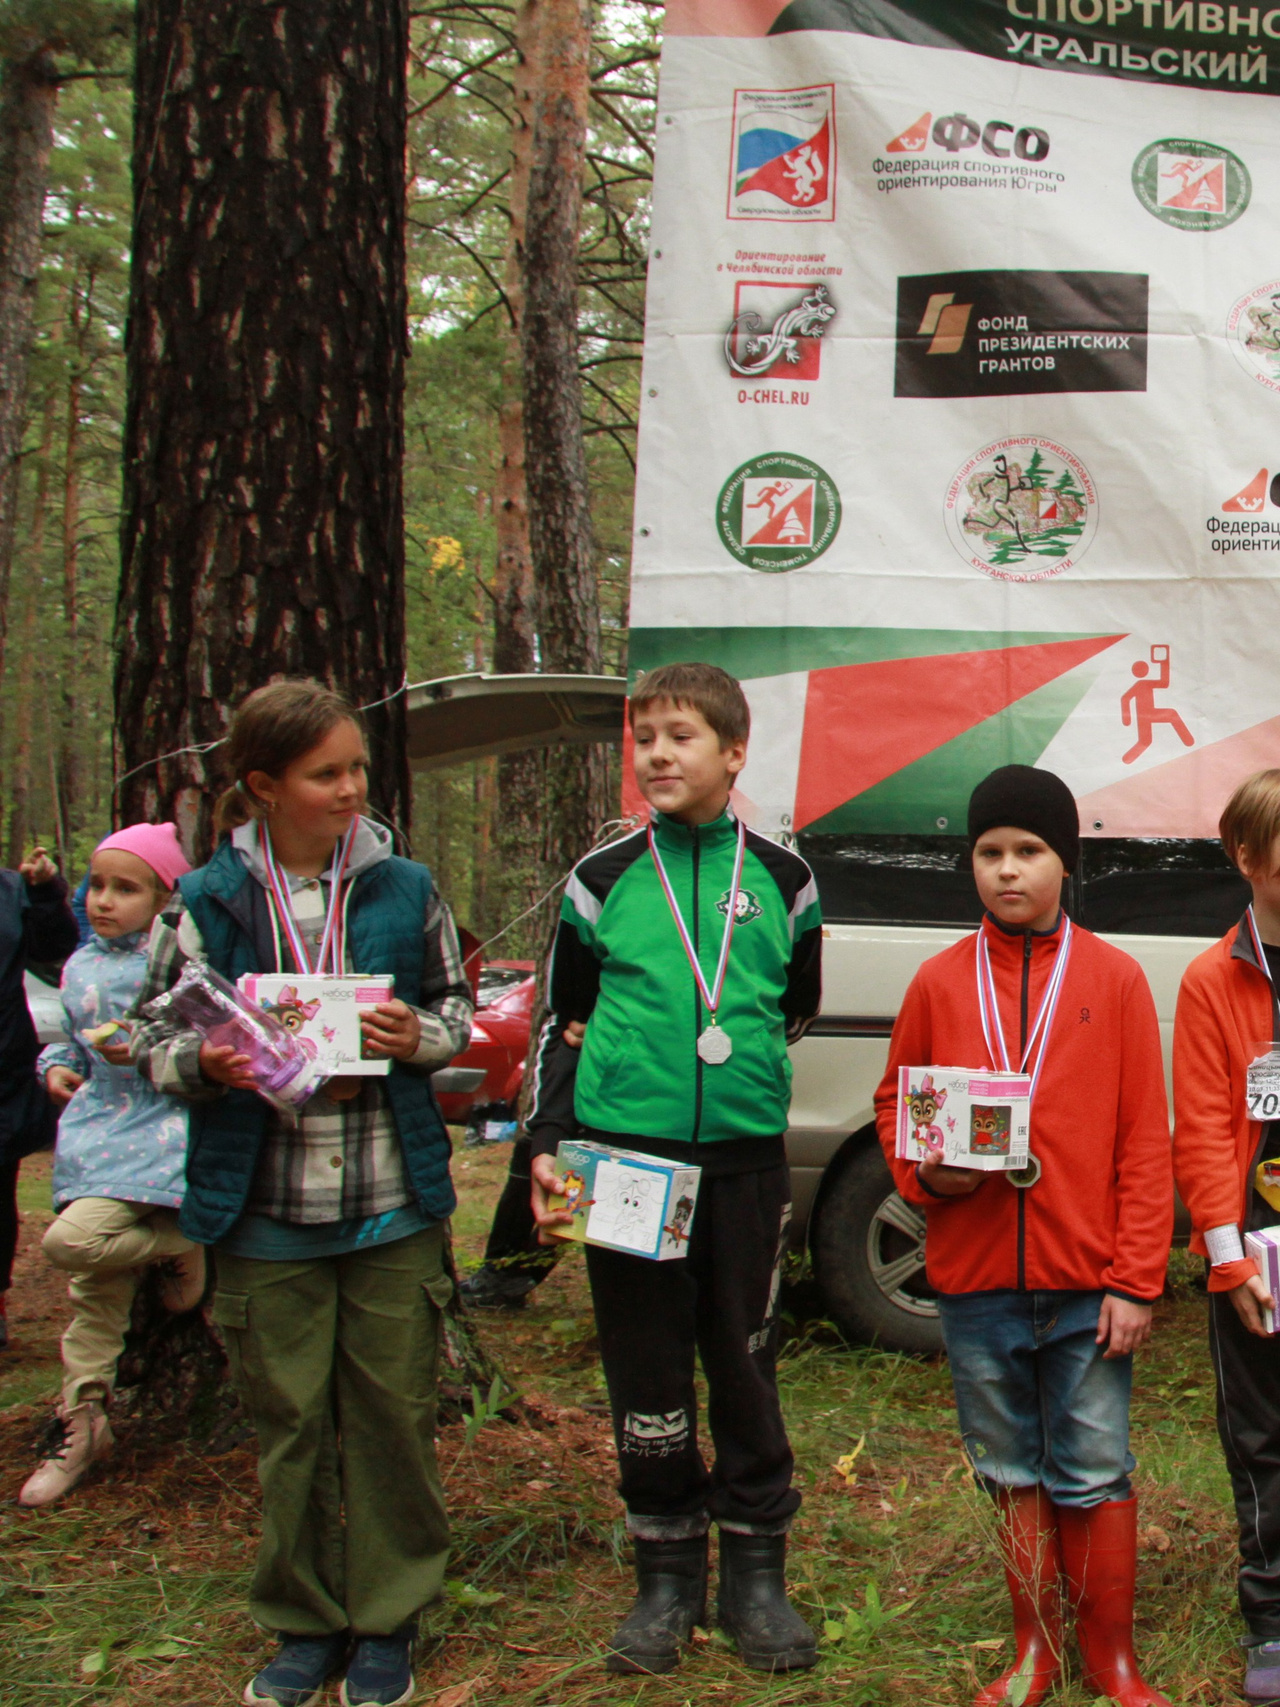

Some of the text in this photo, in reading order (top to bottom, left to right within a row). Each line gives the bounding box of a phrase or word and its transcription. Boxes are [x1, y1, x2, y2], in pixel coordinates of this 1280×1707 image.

[1004, 27, 1268, 85] УРАЛЬСКИЙ
[932, 112, 1050, 162] ФСО
[872, 158, 1065, 182] Федерация спортивного
[878, 176, 1056, 193] ориентирования Югры
[735, 250, 826, 263] Ориентирование
[717, 263, 843, 275] в Челябинской области
[978, 316, 1029, 331] ФОНД
[978, 335, 1130, 352] ПРЕЗИДЕНТСКИХ
[979, 357, 1055, 374] ГРАНТОВ
[738, 390, 810, 405] O-CHEL.RU
[947, 437, 1095, 509] ФЕДЕРАЦИЯ СПОРТИВНОГО ОРИЕНТИРОВАНИЯ
[722, 468, 752, 513] ФЕДЕРАЦИЯ
[757, 457, 818, 477] СПОРТИВНОГО
[971, 557, 1073, 583] КУРГАНСКОЙ ОБЛАСТИ
[948, 1080, 967, 1089] набор
